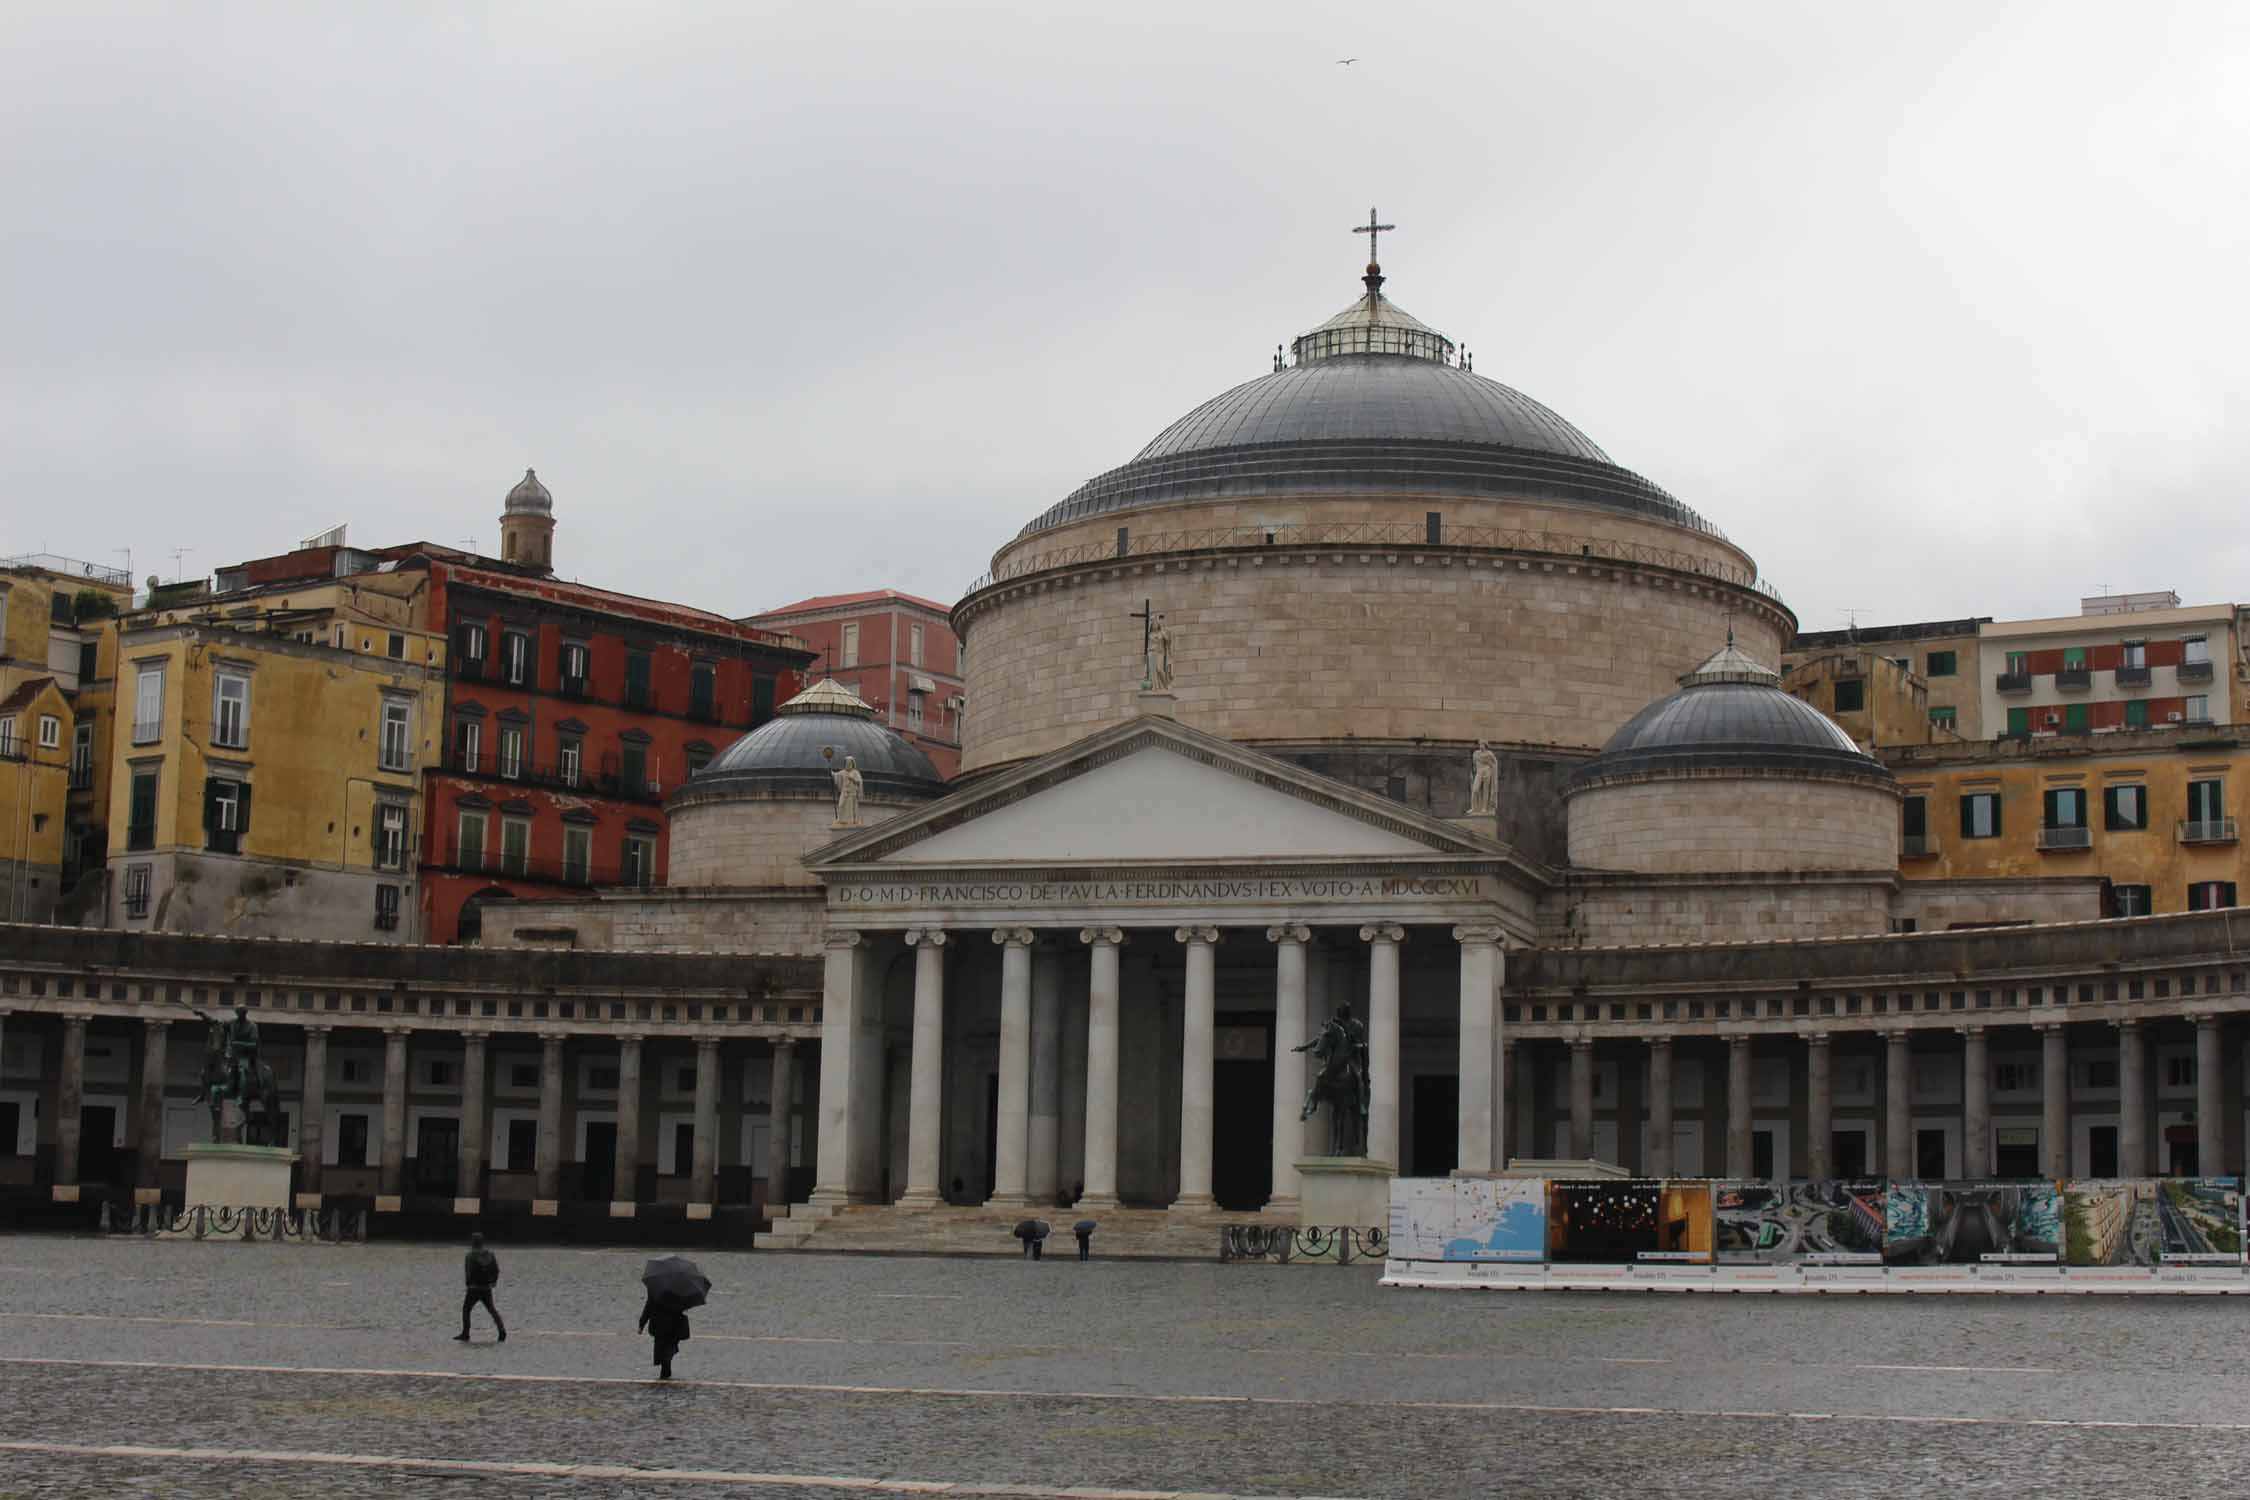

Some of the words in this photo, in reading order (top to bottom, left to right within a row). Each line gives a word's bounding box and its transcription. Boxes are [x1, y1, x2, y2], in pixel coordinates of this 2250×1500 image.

[840, 888, 852, 901] D
[859, 887, 873, 901] O
[880, 887, 895, 901] M
[900, 887, 913, 901] D
[920, 886, 1022, 901] FRANCISCO
[1030, 885, 1050, 900] DE
[1126, 883, 1252, 898] FERDINANDVS
[1270, 881, 1294, 896] EX
[1301, 881, 1353, 896] VOTO
[1381, 880, 1479, 895] MDCCCXVI
